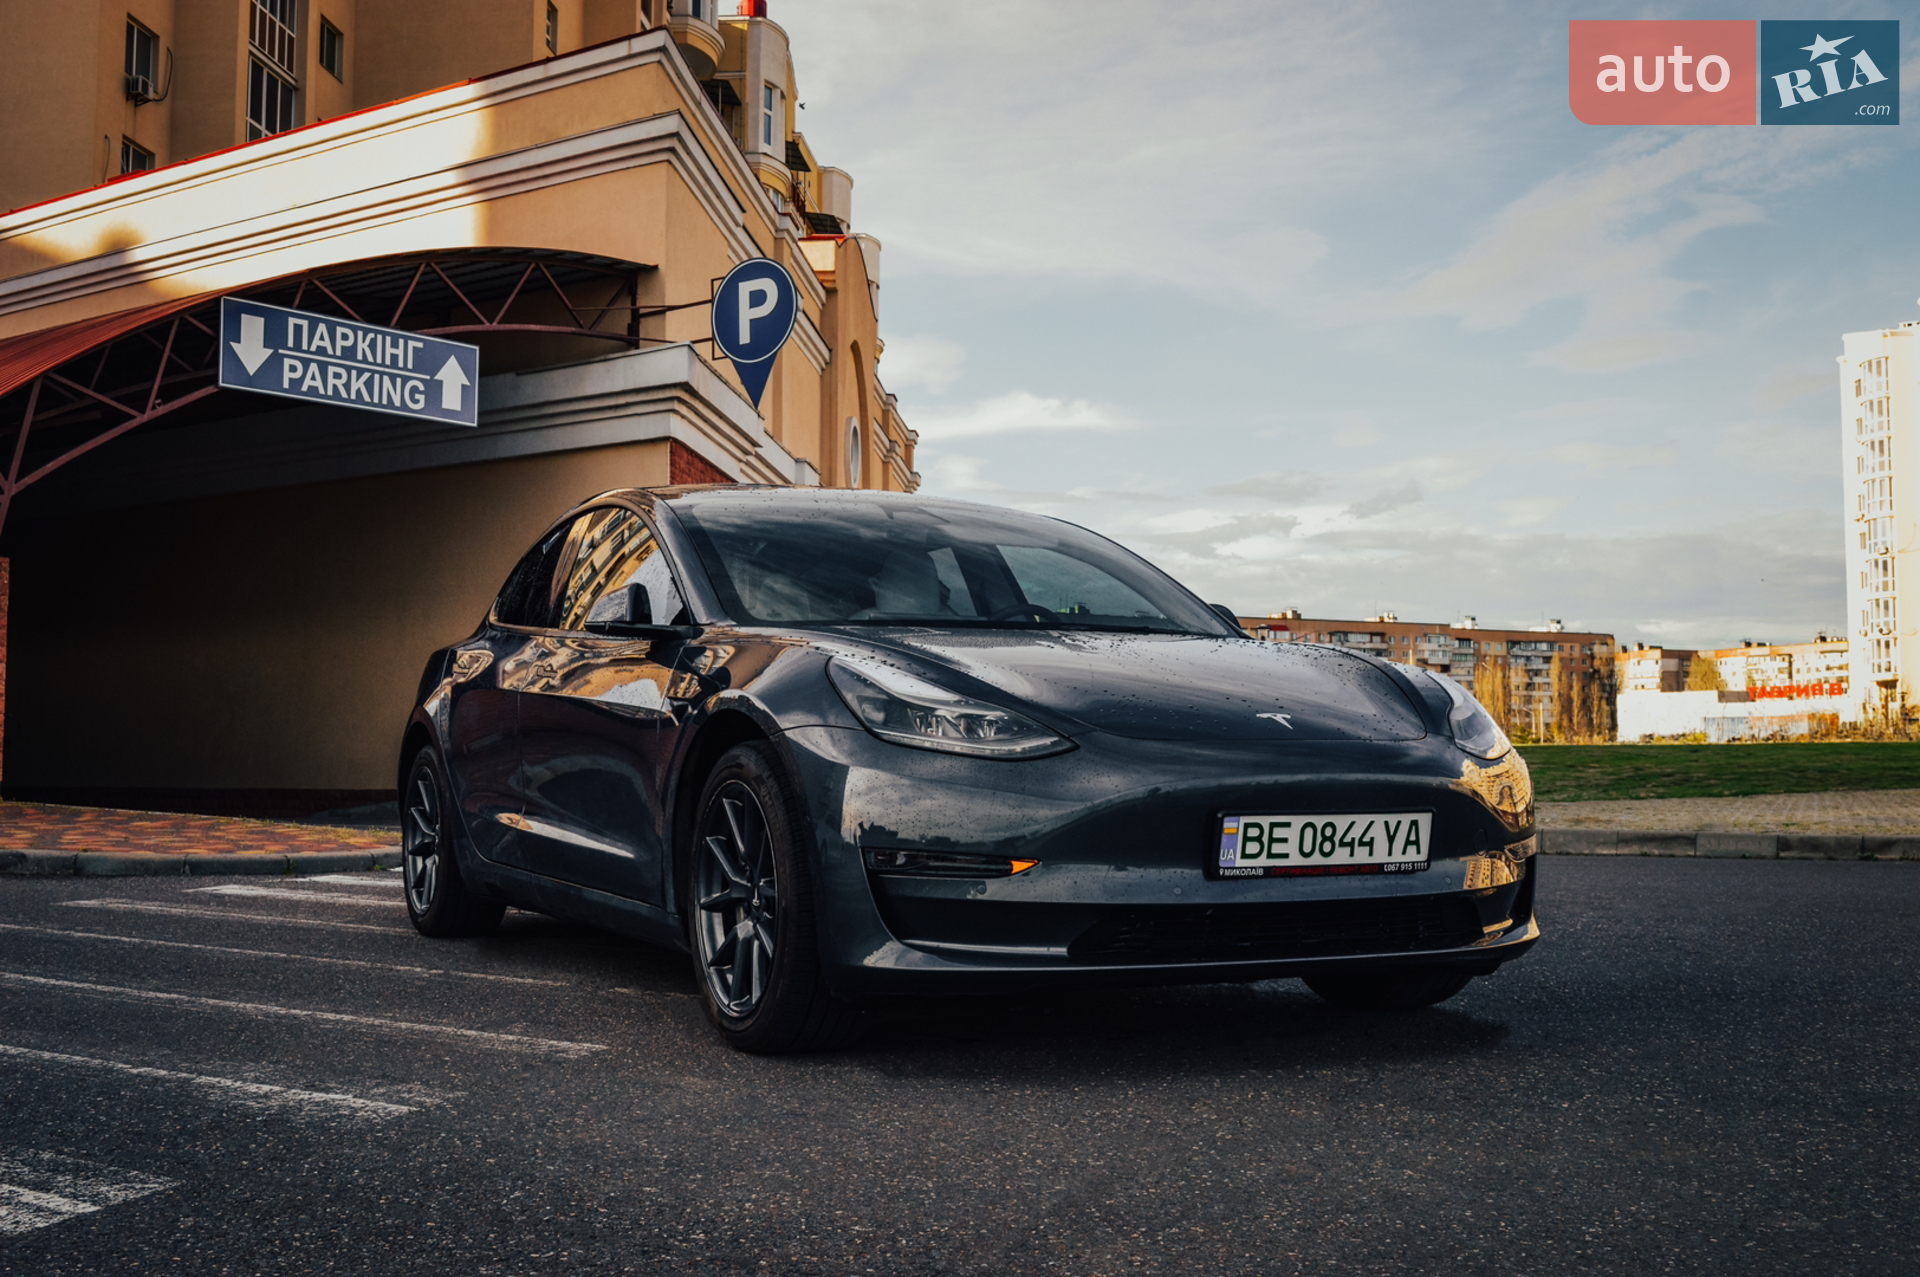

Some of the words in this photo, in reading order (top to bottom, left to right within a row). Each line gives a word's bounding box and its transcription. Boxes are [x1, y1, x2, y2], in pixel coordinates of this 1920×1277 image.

[738, 277, 779, 346] P
[287, 316, 424, 370] ПАРКІНГ
[282, 357, 426, 410] PARKING
[1220, 848, 1235, 861] UA
[1240, 821, 1292, 860] BE
[1298, 820, 1375, 859] 0844
[1382, 819, 1422, 857] YA
[1224, 867, 1264, 876] МИКОЛАЇВ
